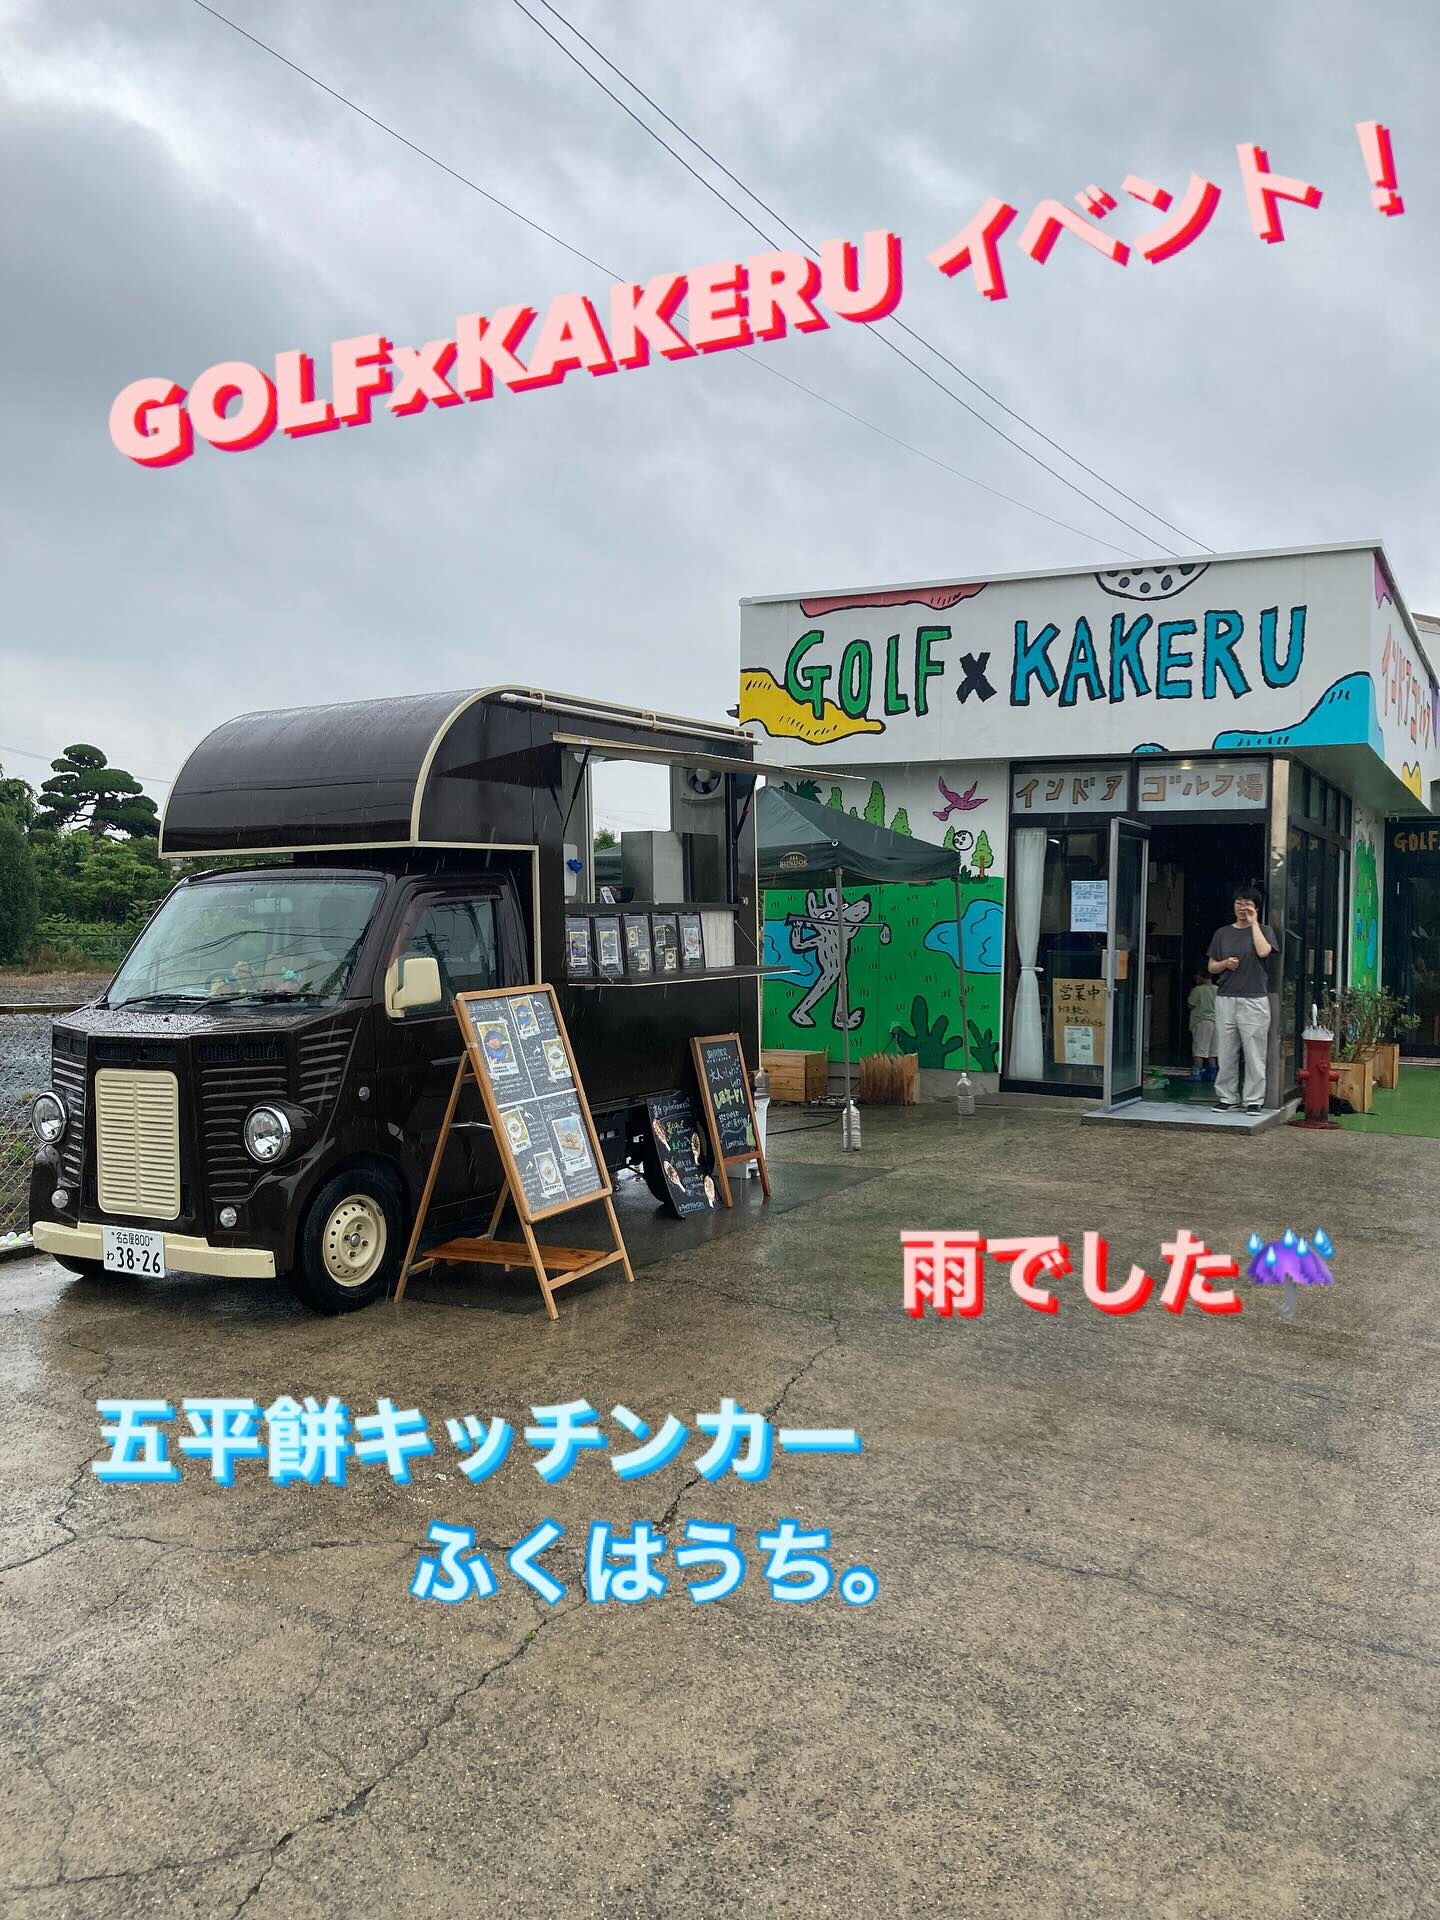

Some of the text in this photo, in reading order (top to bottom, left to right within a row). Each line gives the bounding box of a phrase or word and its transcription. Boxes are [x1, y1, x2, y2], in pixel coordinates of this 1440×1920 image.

[785, 626, 952, 721] GOLF
[1010, 605, 1307, 707] KAKERU
[1016, 773, 1264, 808] インドア ゴルフ場
[1058, 983, 1101, 1001] 営業中
[107, 1247, 160, 1273] わ 38-26
